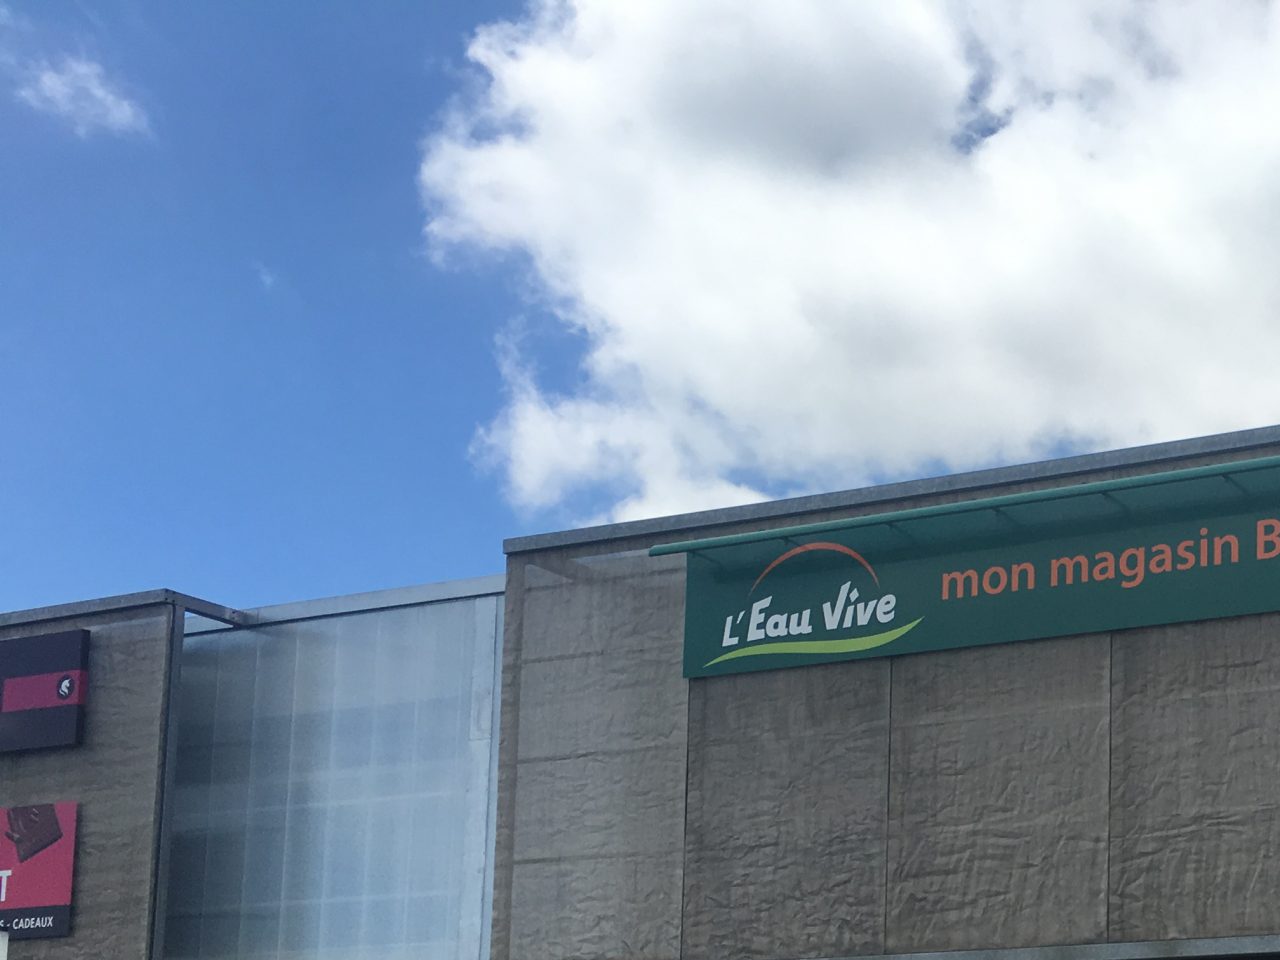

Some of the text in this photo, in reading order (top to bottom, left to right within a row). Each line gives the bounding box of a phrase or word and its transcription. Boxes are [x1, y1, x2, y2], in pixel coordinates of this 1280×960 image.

[941, 561, 1036, 601] mon
[1051, 528, 1239, 589] magasin
[721, 580, 897, 648] L'Eau Vive
[12, 916, 54, 930] CADEAUX
